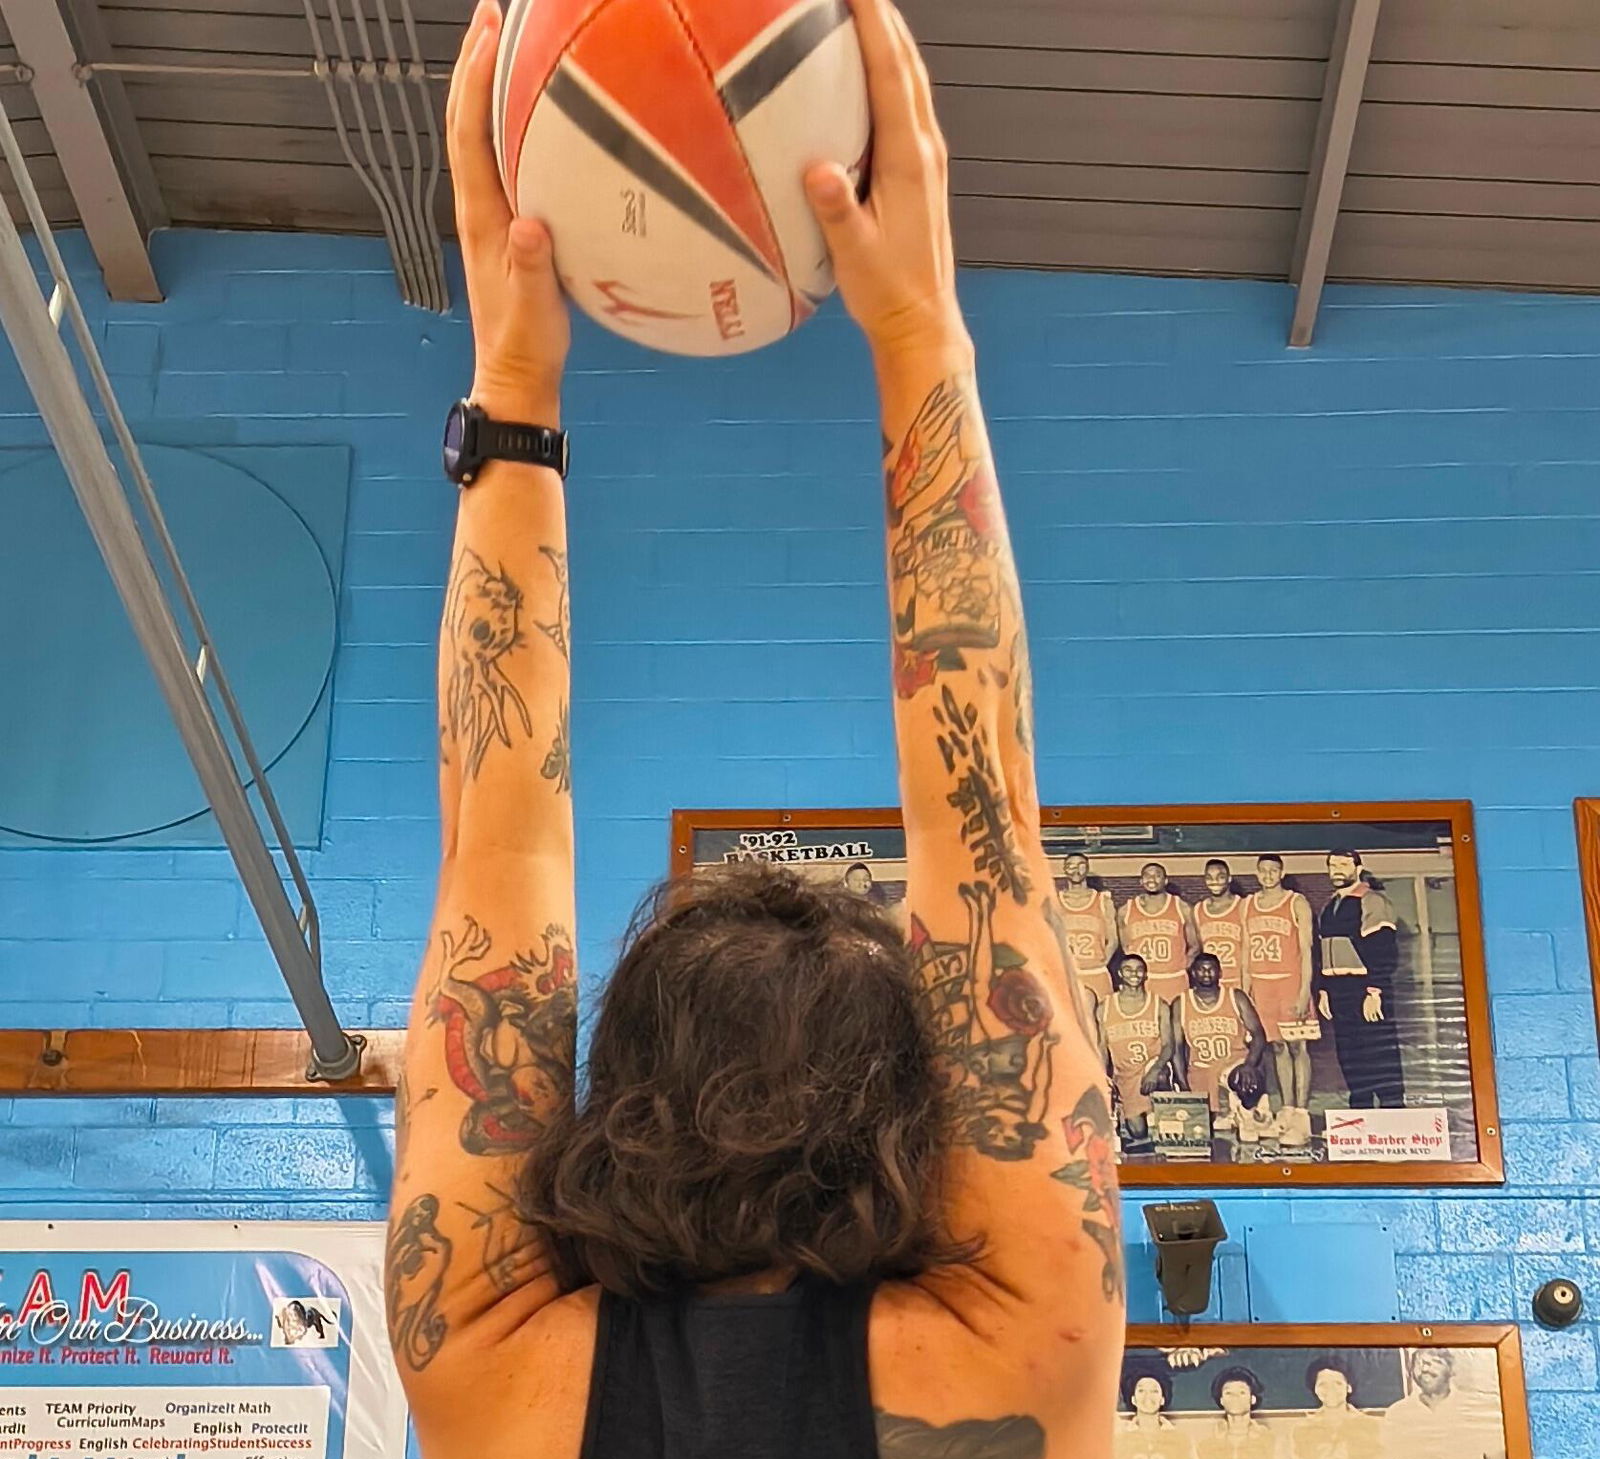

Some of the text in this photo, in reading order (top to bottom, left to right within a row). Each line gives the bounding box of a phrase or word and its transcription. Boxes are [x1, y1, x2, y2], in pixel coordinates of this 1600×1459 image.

[724, 843, 872, 864] BASKETBALL
[1139, 936, 1171, 962] 40
[1250, 934, 1282, 962] 24
[1128, 1040, 1148, 1065] 3
[1193, 1035, 1231, 1061] 30
[1368, 1134, 1407, 1146] Barber
[1411, 1133, 1443, 1147] Shop
[30, 1299, 102, 1345] Our
[61, 1345, 120, 1365] Protect
[149, 1345, 213, 1365] Reward
[45, 1402, 82, 1415] TEAM
[87, 1402, 137, 1417] Priority
[238, 1402, 272, 1414] Math
[0, 1422, 26, 1435] rdIt
[56, 1416, 166, 1431] CurriculumMaps
[193, 1421, 243, 1436] English
[79, 1437, 128, 1452] English
[132, 1436, 313, 1452] CelebratingStudentSuccess
